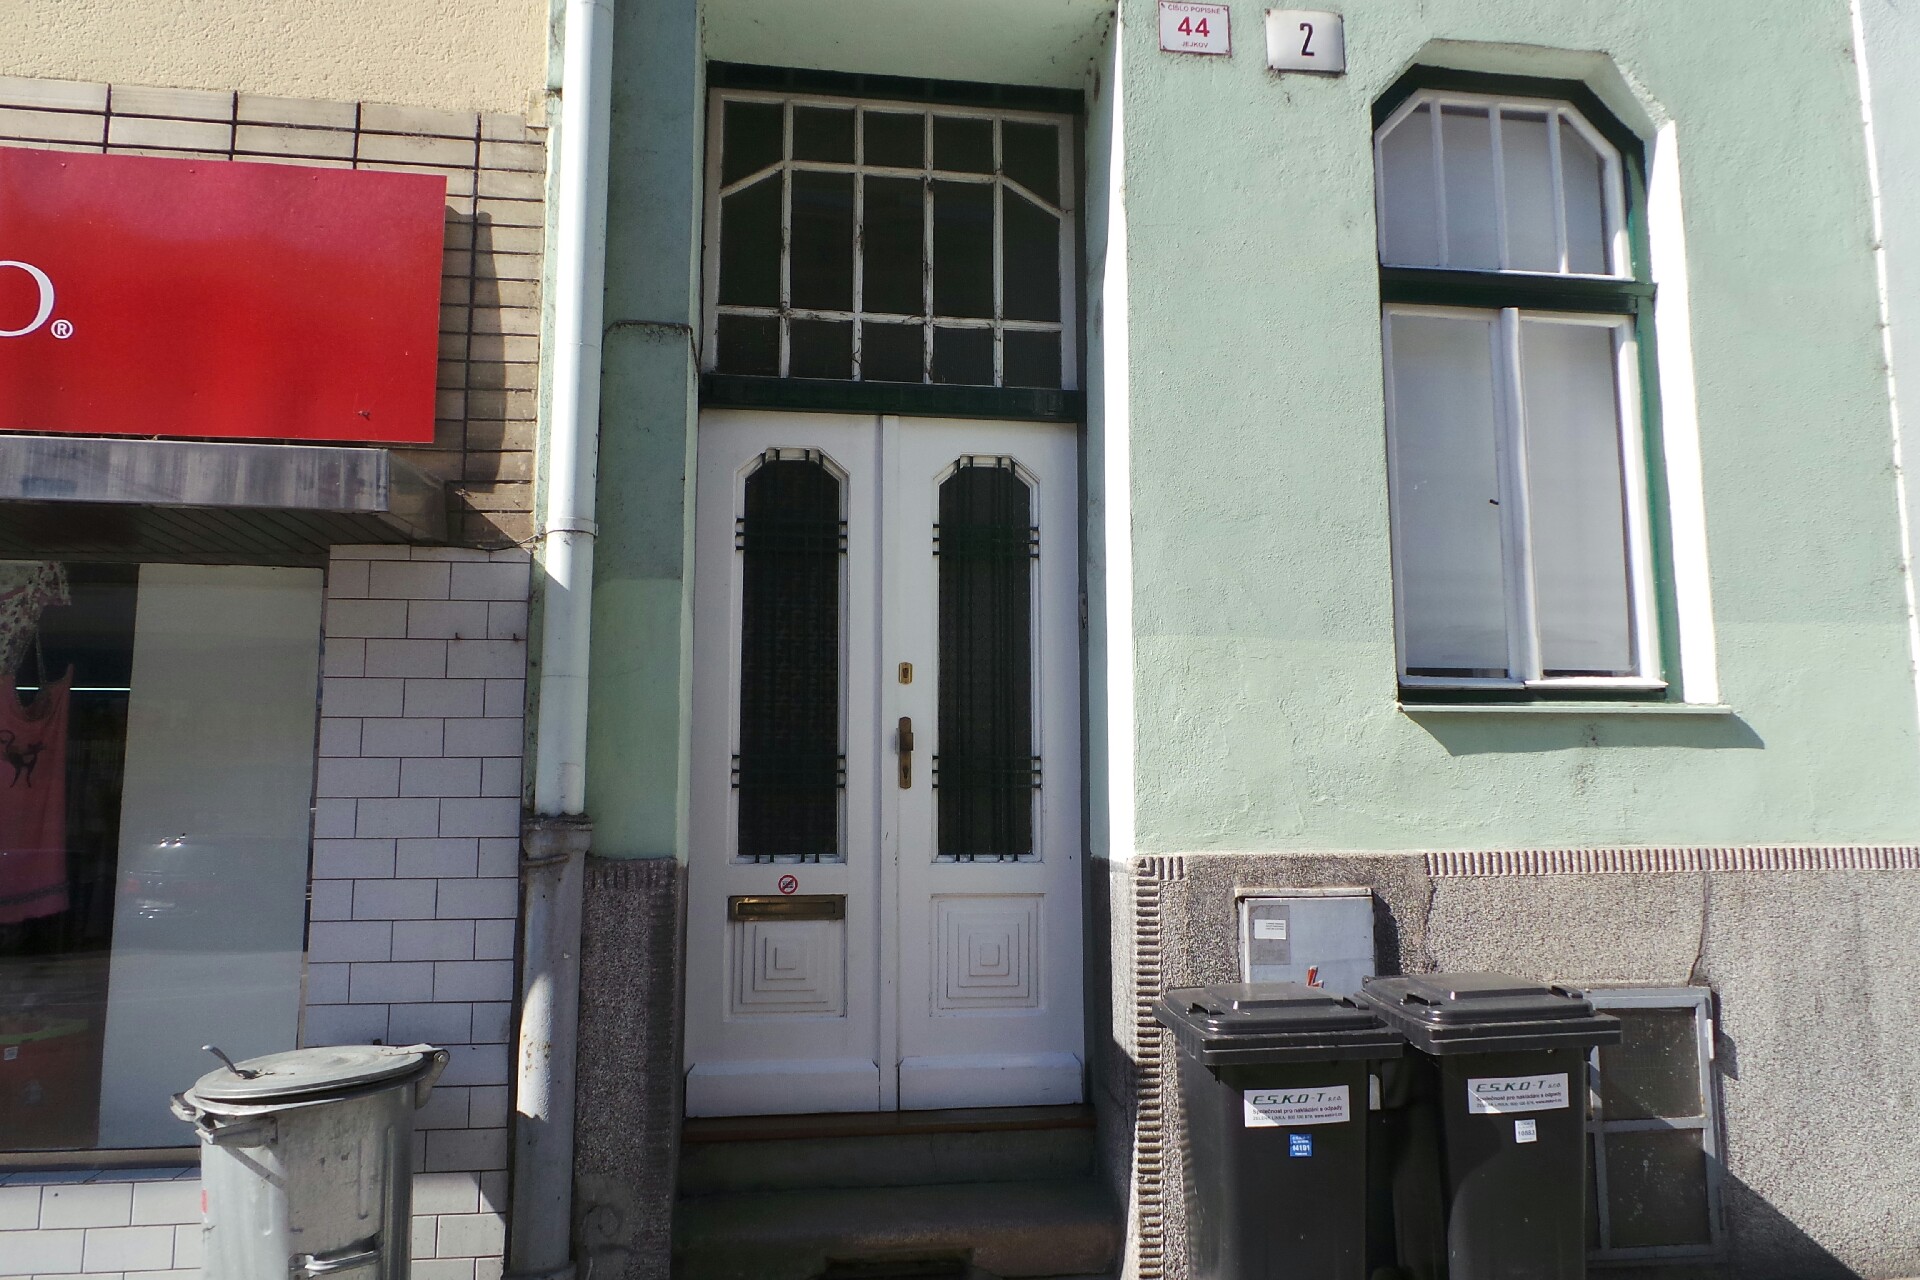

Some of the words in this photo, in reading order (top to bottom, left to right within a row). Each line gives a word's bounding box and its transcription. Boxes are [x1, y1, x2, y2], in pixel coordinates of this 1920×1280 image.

[1177, 16, 1210, 37] 44
[1299, 22, 1315, 56] 2
[1476, 1080, 1546, 1092] ESKO-T
[1253, 1092, 1327, 1105] ESKO-T
